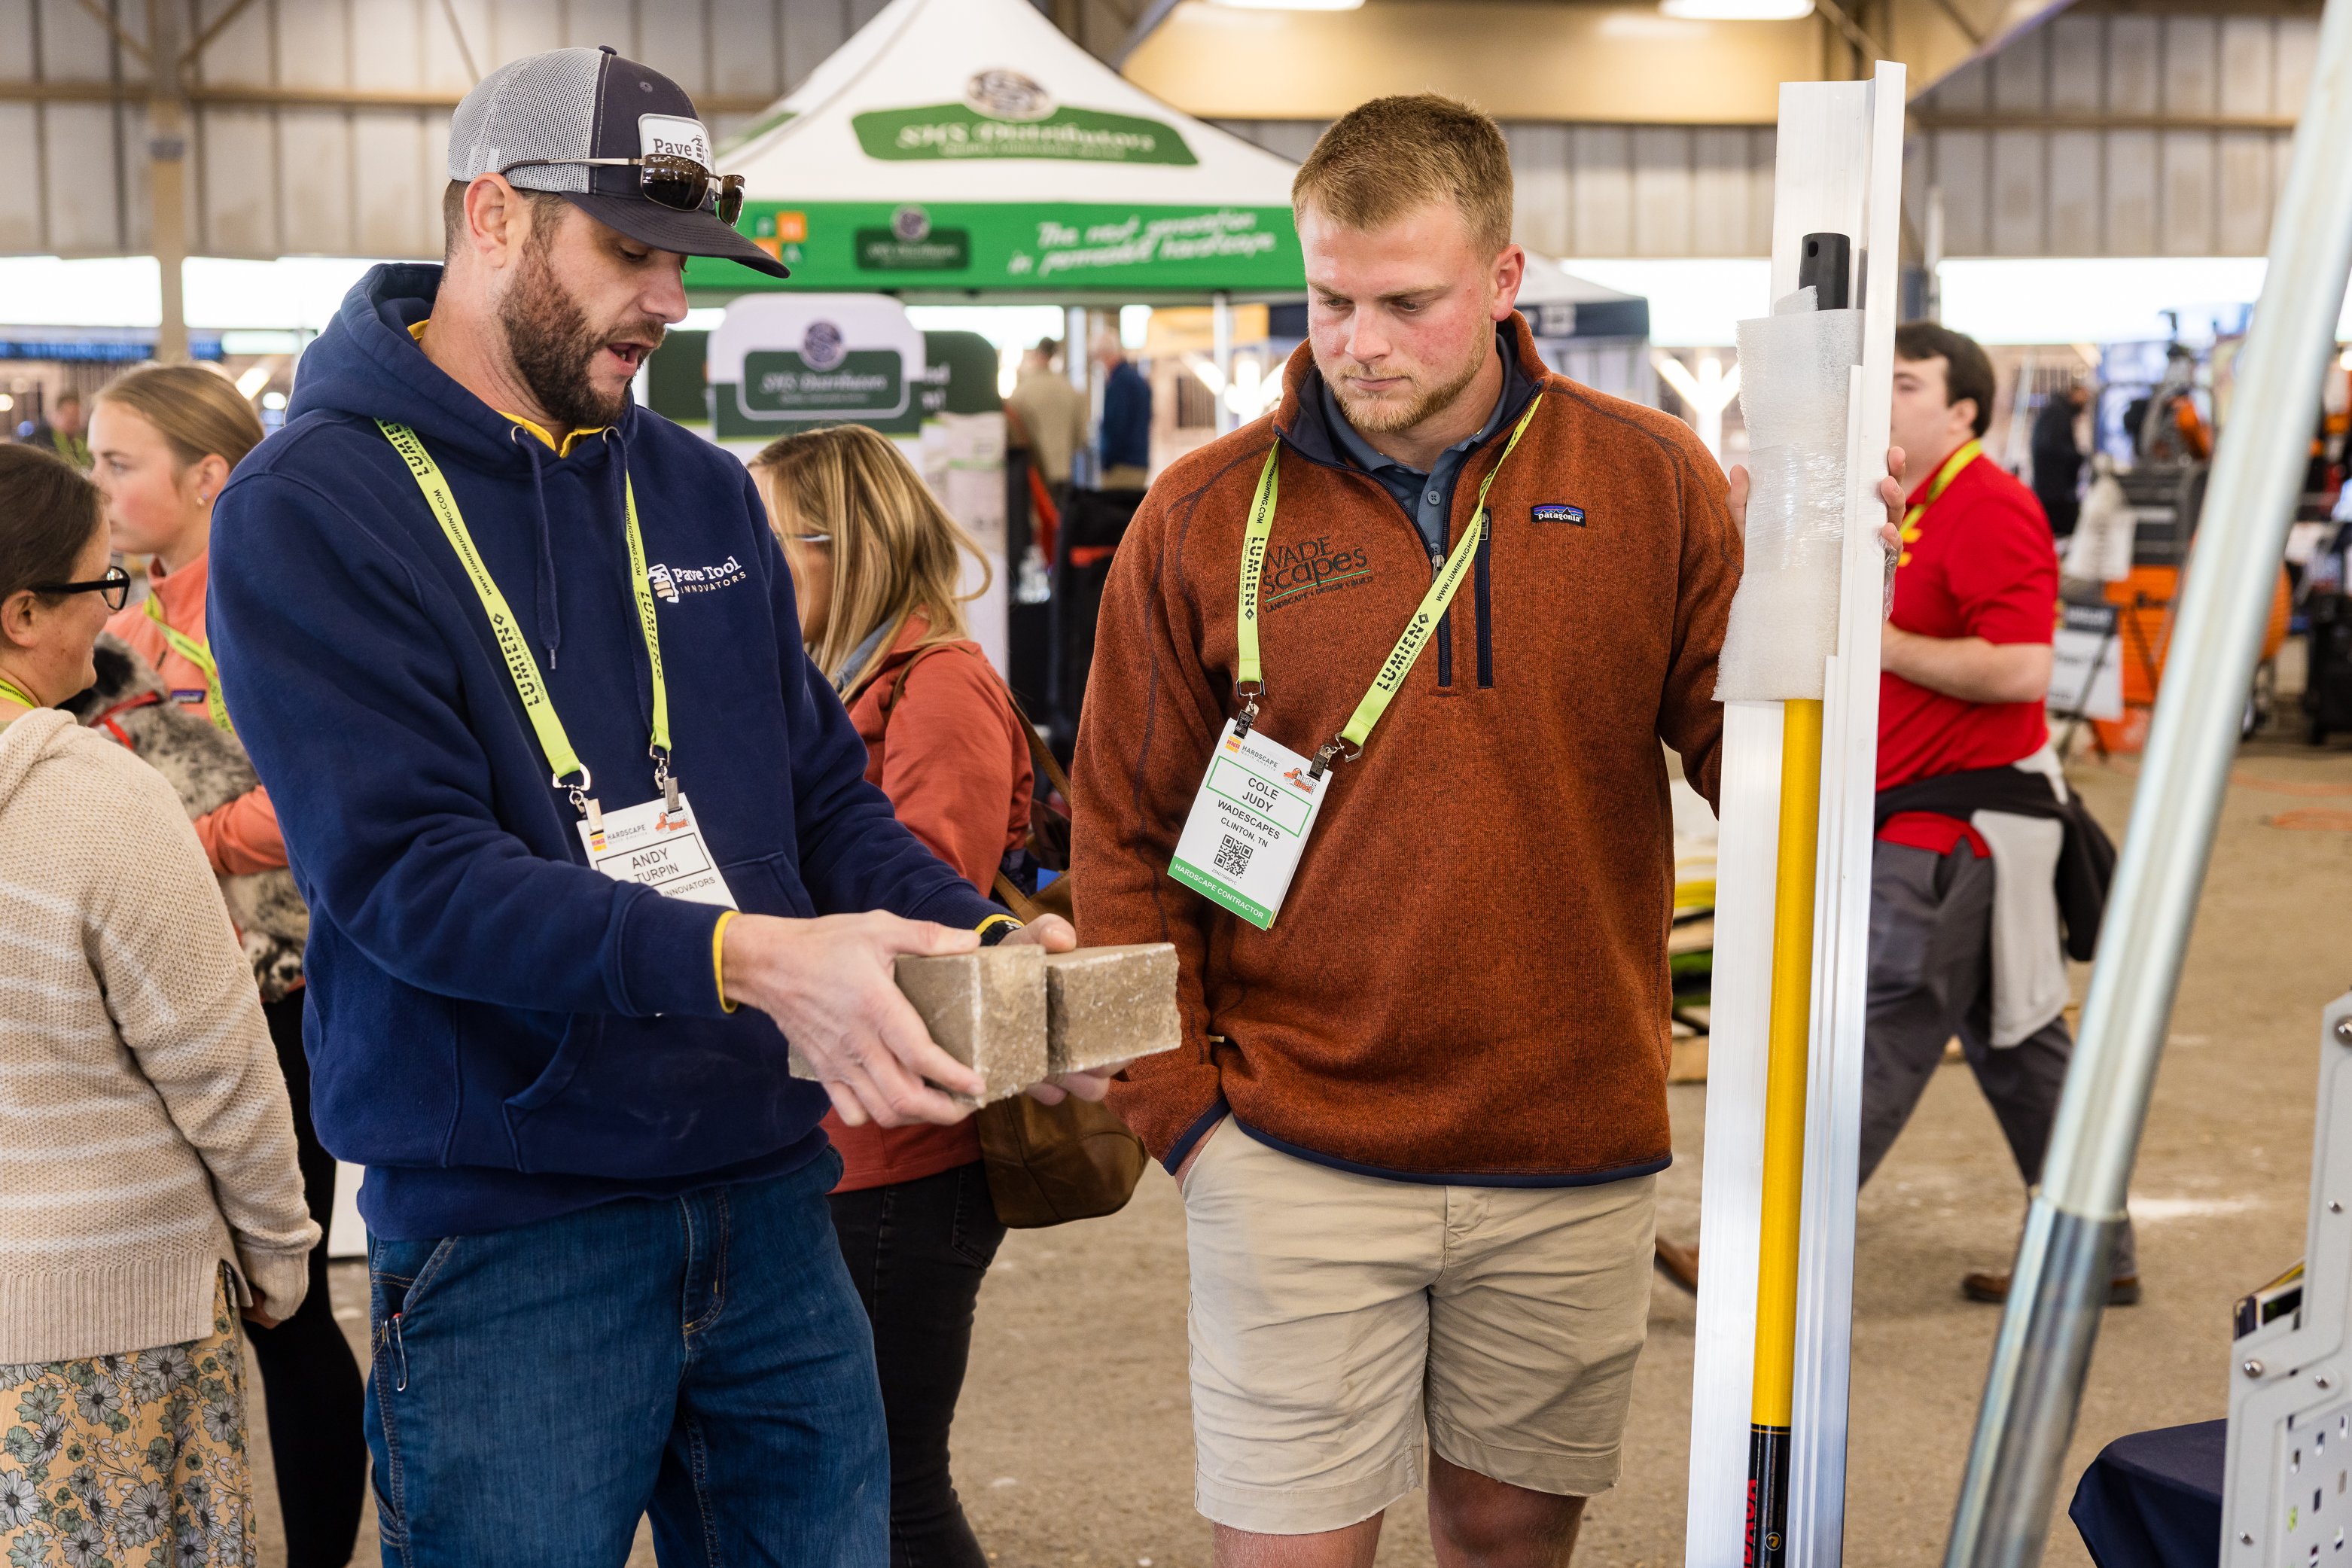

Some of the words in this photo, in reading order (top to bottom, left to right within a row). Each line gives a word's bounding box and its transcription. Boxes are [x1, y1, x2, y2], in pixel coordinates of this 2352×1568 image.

[653, 138, 692, 156] Pave
[1538, 512, 1580, 522] patagonia
[434, 489, 492, 596] WWW.LUMIENLIGHTING.COM
[1262, 535, 1334, 574] WADE
[1436, 512, 1482, 601] WWW.LUMIENLIGHTING.CO
[672, 568, 705, 583] Pave
[702, 556, 742, 579] Tool
[681, 571, 746, 593] INNOVATORS
[1245, 537, 1265, 606] LUMIEN
[1263, 547, 1368, 595] scapes
[640, 591, 660, 667] LUMIEN
[498, 627, 540, 706] LUMIEN
[1376, 623, 1424, 690] LUMIEN
[1242, 745, 1278, 768] HARDSCAPE
[1242, 791, 1274, 813] JUDY
[1248, 778, 1279, 800] COLE
[607, 824, 646, 840] HARDSCAPE
[1217, 799, 1281, 840] WADESCAPES
[1220, 817, 1255, 842] CLINTON,
[1257, 836, 1269, 848] TN
[632, 848, 668, 869] ANDY
[634, 863, 679, 882] TURPIN
[664, 877, 716, 897] INNOVATORS
[1174, 863, 1217, 891] HARDSCAPE
[1217, 888, 1264, 918] CONTRACTOR
